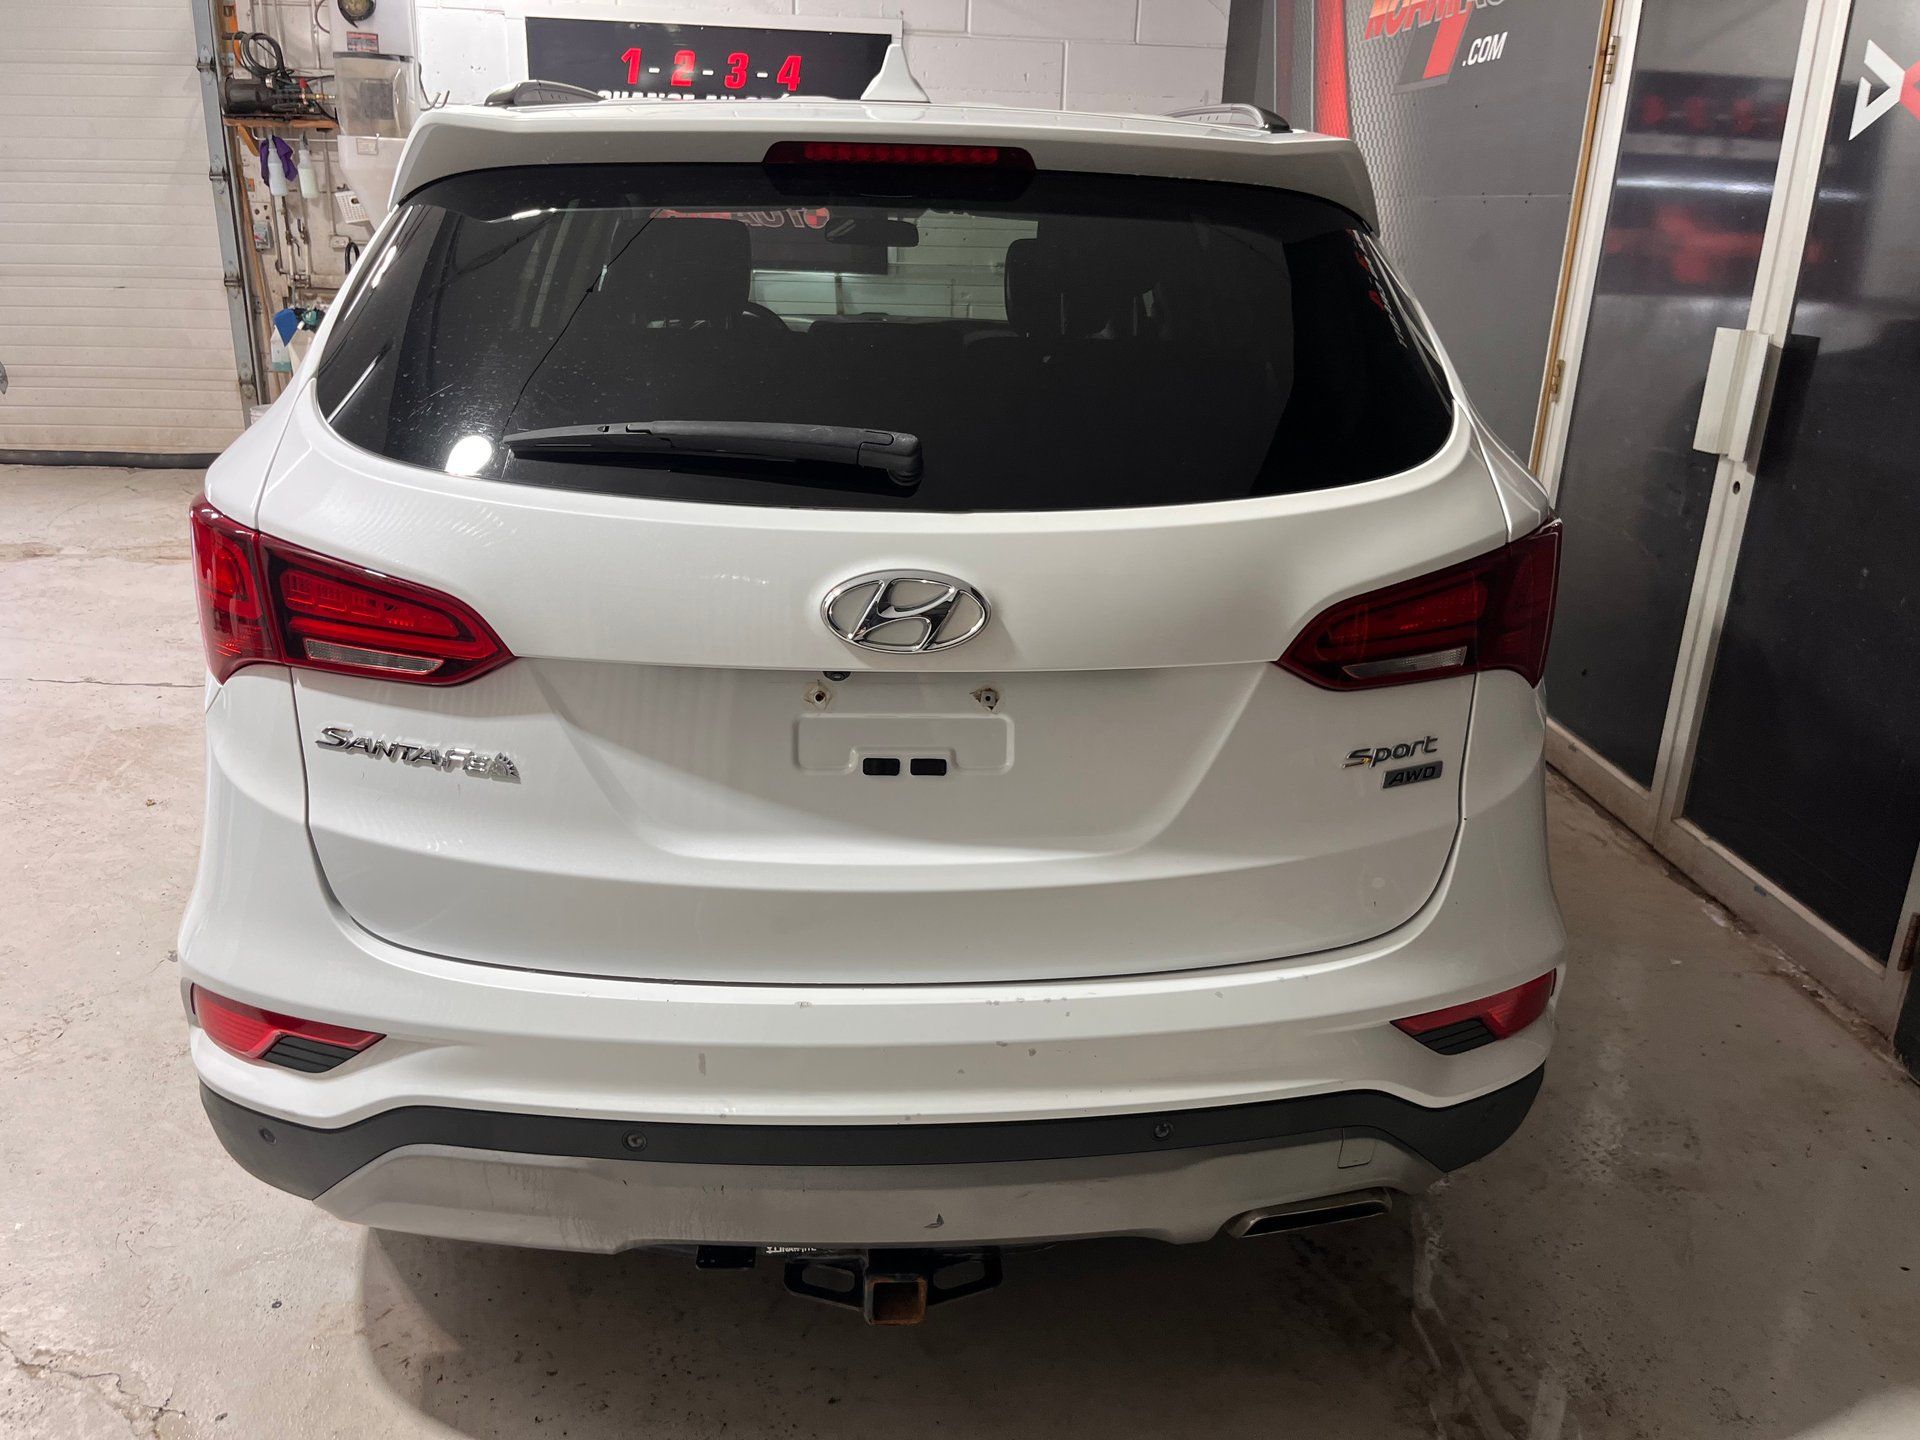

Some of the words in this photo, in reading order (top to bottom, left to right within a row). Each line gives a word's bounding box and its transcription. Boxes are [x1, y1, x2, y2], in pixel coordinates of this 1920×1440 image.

[1462, 31, 1508, 67] .COM
[1343, 736, 1438, 768] Sport
[1387, 765, 1437, 786] AWD
